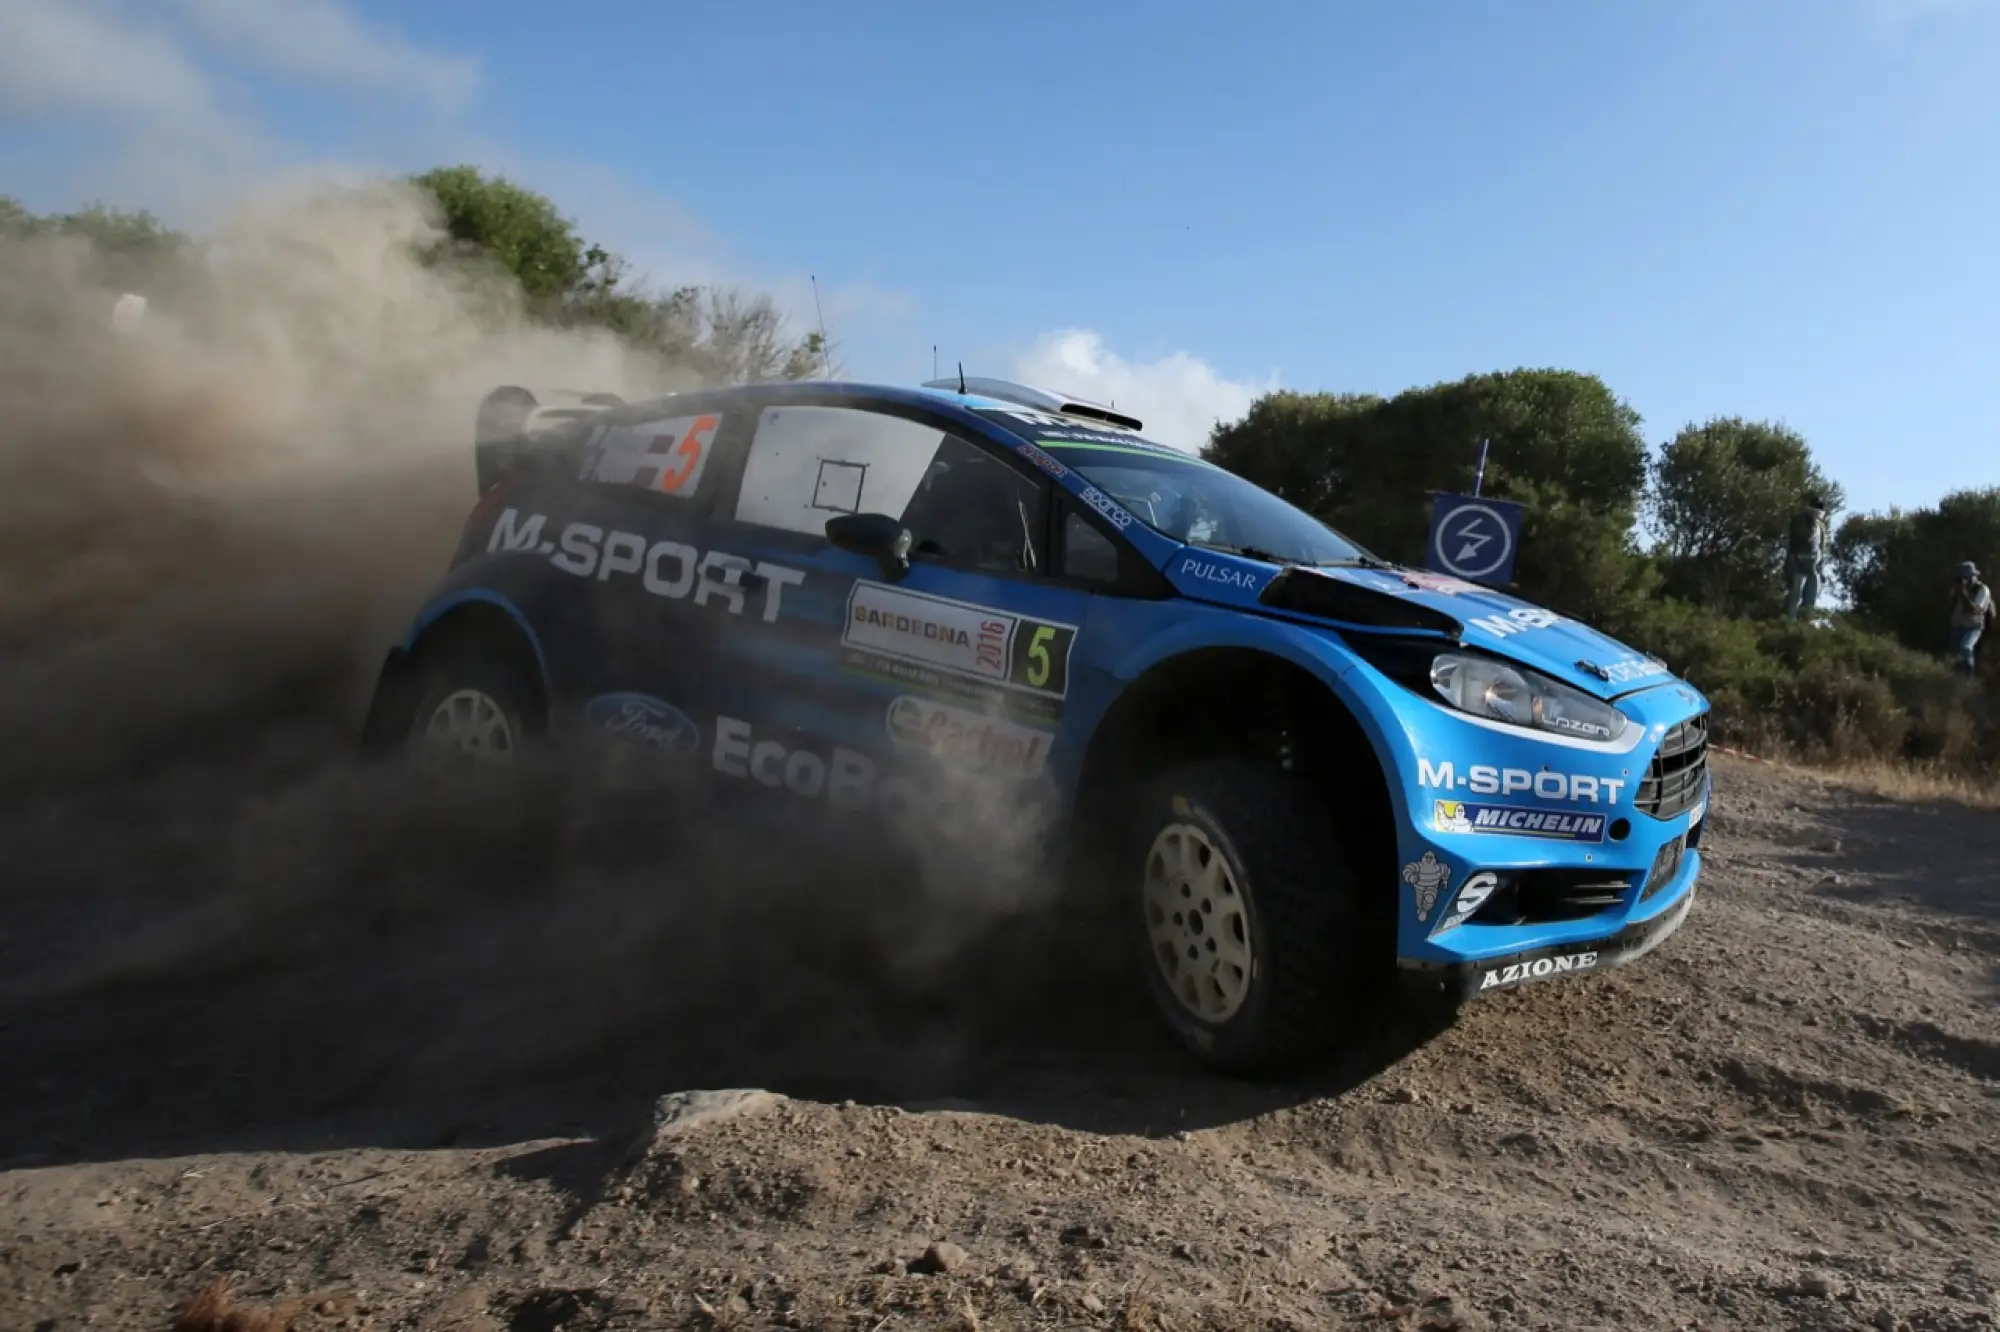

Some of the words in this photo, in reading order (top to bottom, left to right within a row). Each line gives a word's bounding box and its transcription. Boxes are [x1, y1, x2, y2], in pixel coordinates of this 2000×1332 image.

[663, 415, 717, 493] 5
[486, 507, 806, 623] M-SPORT
[1180, 557, 1257, 590] PULSAR
[855, 605, 970, 649] SARDEGNA
[976, 620, 1006, 669] 2016
[1027, 625, 1056, 687] 5
[604, 700, 683, 749] Ford
[1417, 757, 1625, 805] M-SPORT
[1474, 811, 1602, 834] MICHELIN
[1479, 950, 1599, 991] AZIONE
